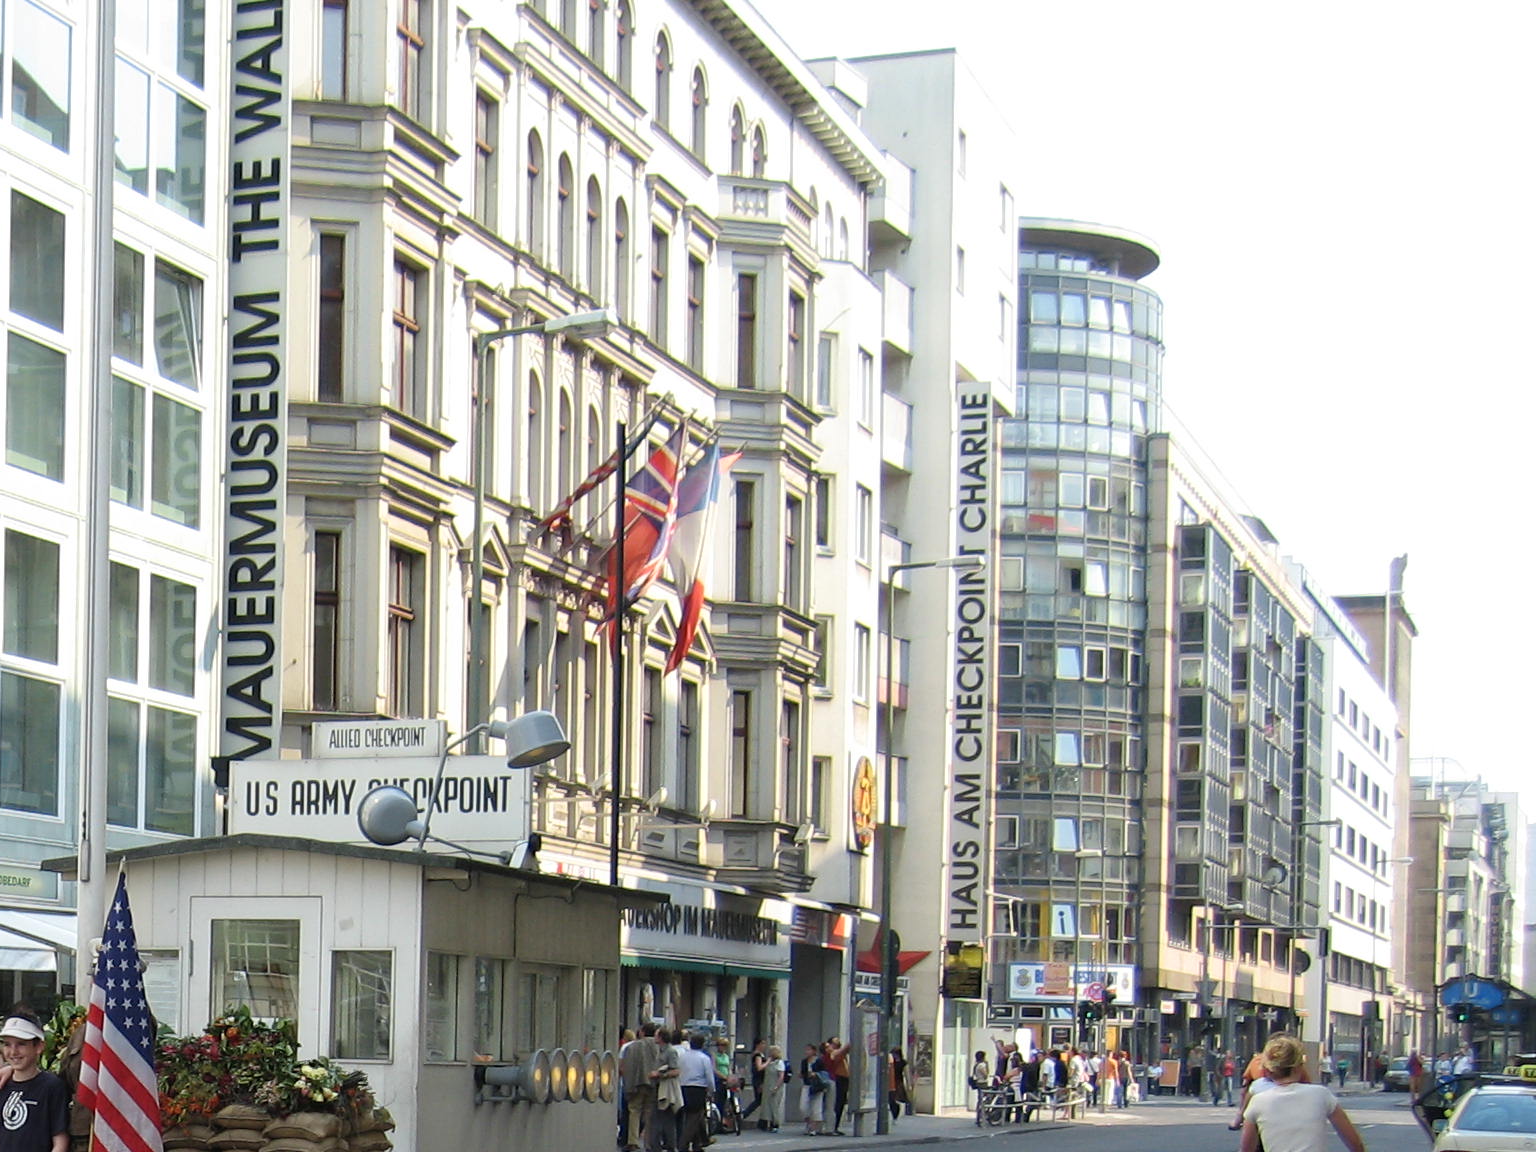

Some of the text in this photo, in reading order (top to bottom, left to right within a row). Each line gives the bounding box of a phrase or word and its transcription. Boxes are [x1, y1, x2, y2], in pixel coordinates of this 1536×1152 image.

[232, 158, 281, 263] THE
[225, 291, 281, 762] MAUERMUSEUM
[950, 393, 989, 930] HAUS AM CHECKPOINT CHARLIE
[329, 726, 427, 749] ALLIED CHECKPOINT
[246, 775, 512, 816] US ARMY CKPOINT
[620, 901, 681, 934] AUERSHOP
[683, 904, 698, 935] IM
